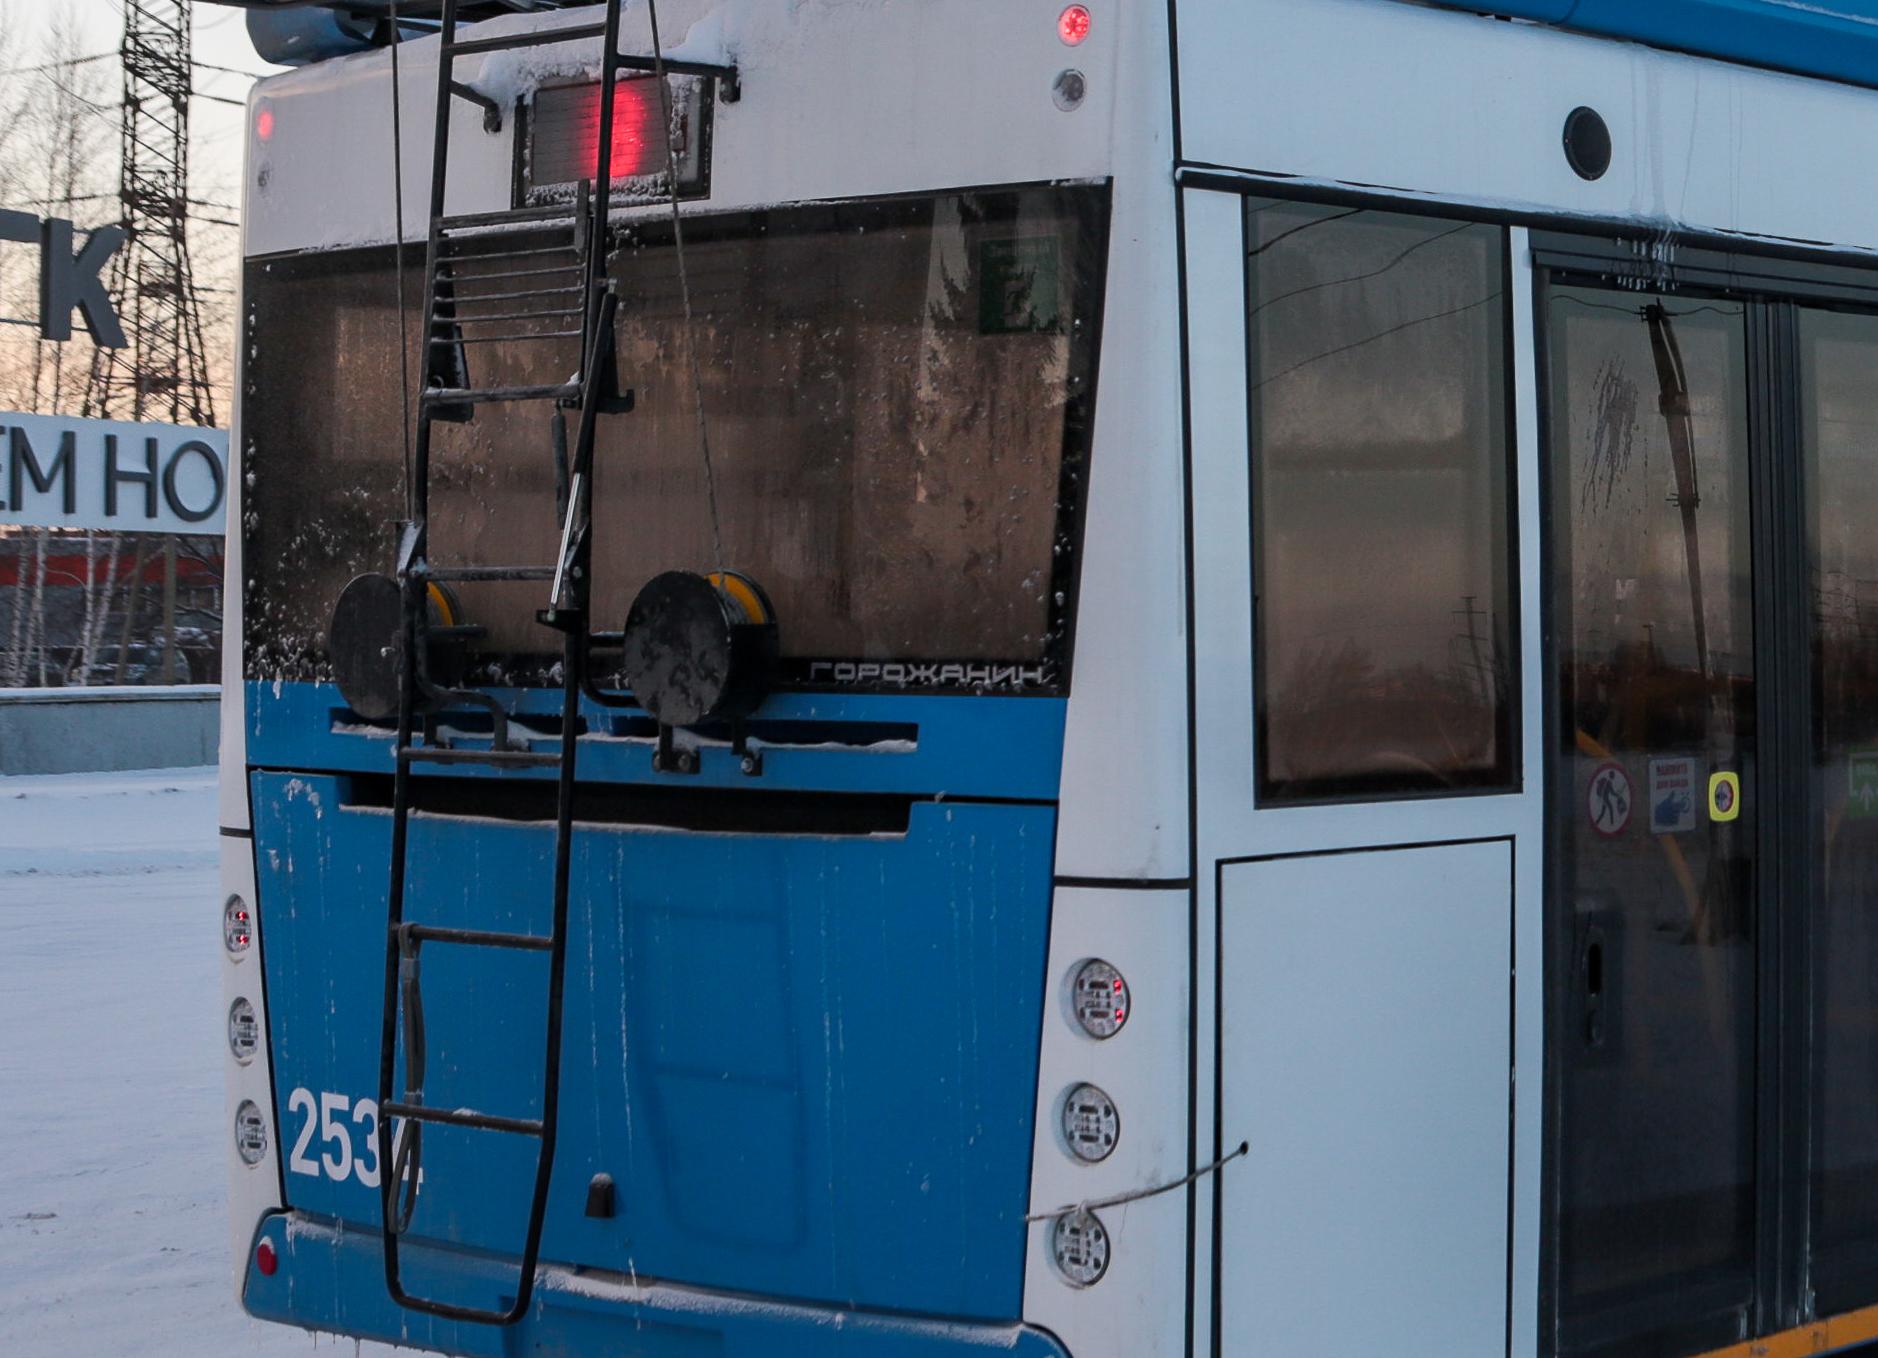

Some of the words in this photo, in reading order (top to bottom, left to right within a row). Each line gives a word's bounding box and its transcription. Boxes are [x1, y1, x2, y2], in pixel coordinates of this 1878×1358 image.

[0, 425, 76, 514] М
[104, 434, 229, 522] НО
[810, 661, 1043, 685] ГОРОЖАНИН
